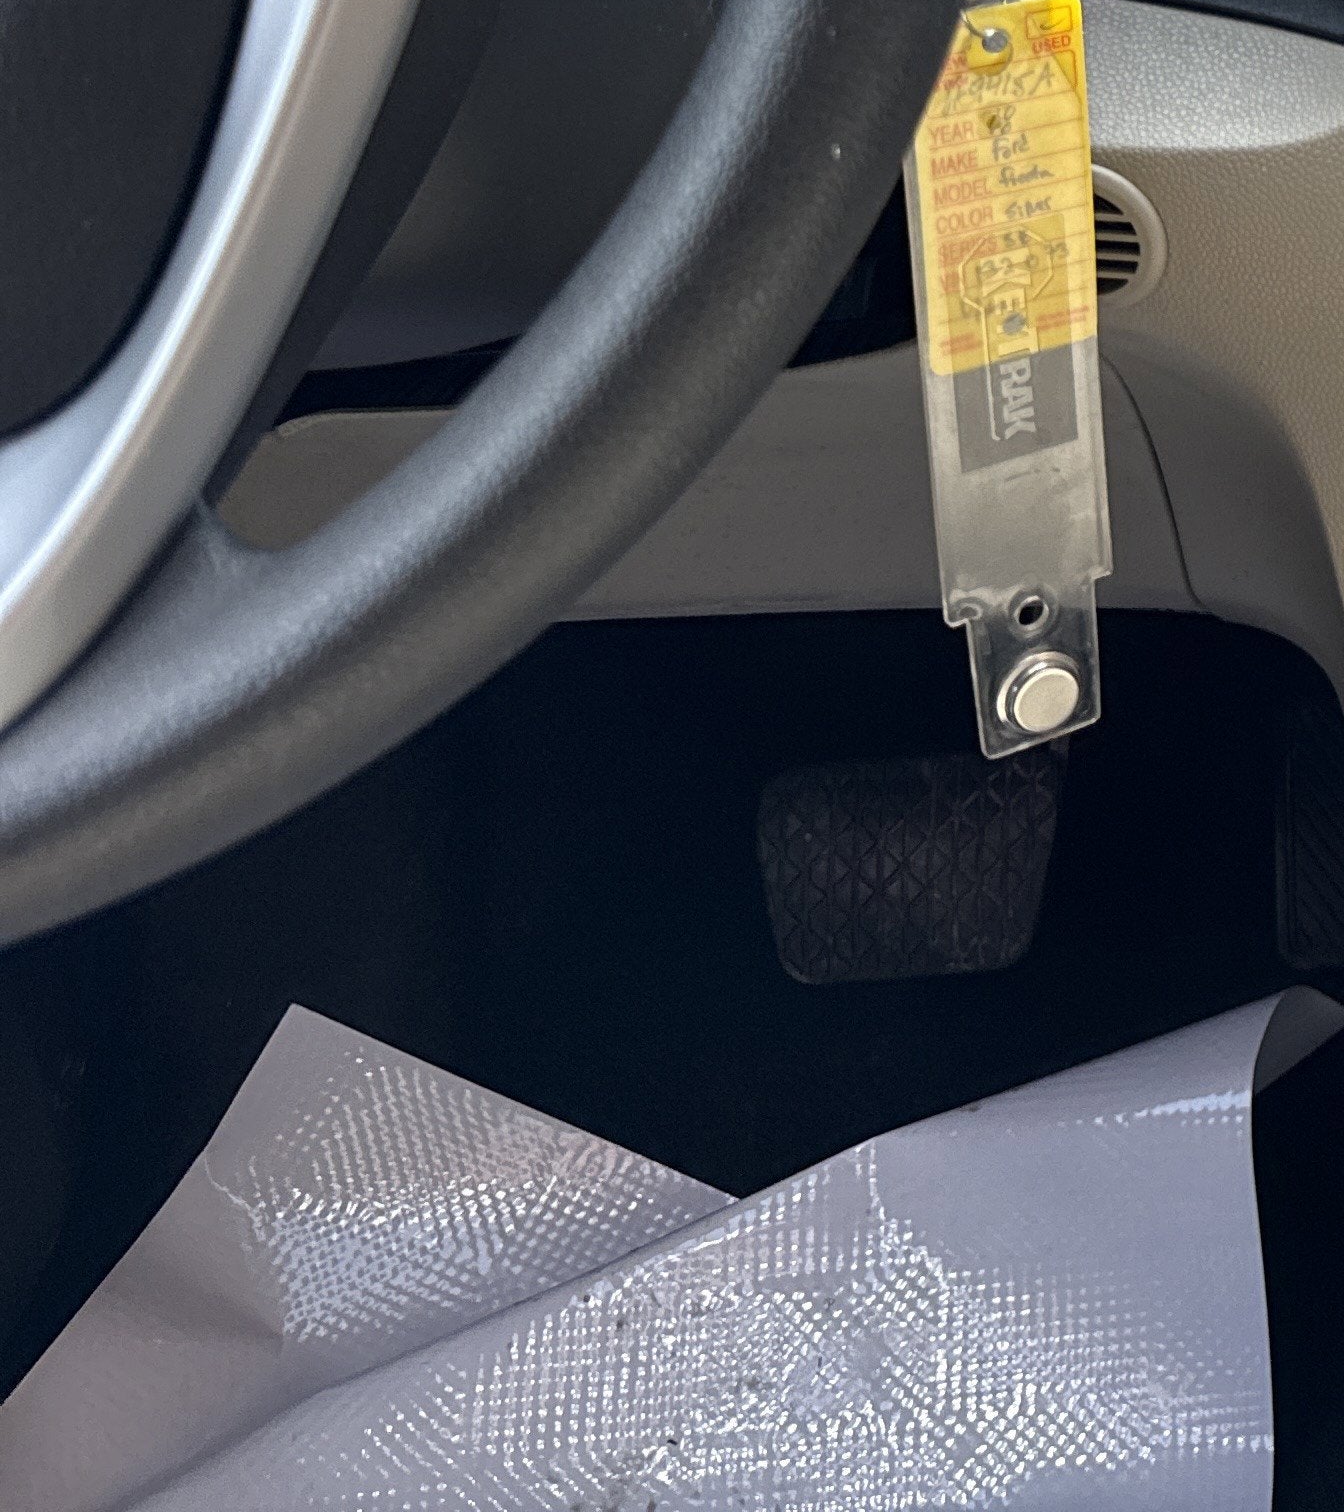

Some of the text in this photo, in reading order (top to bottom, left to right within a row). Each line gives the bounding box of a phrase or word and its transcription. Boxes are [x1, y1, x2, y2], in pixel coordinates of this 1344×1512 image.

[1032, 35, 1071, 54] USED
[930, 121, 975, 145] YEAR
[931, 149, 979, 176] MAKE
[934, 177, 992, 205] MODEL
[936, 205, 993, 235] COLOR
[939, 237, 998, 266] SERIES
